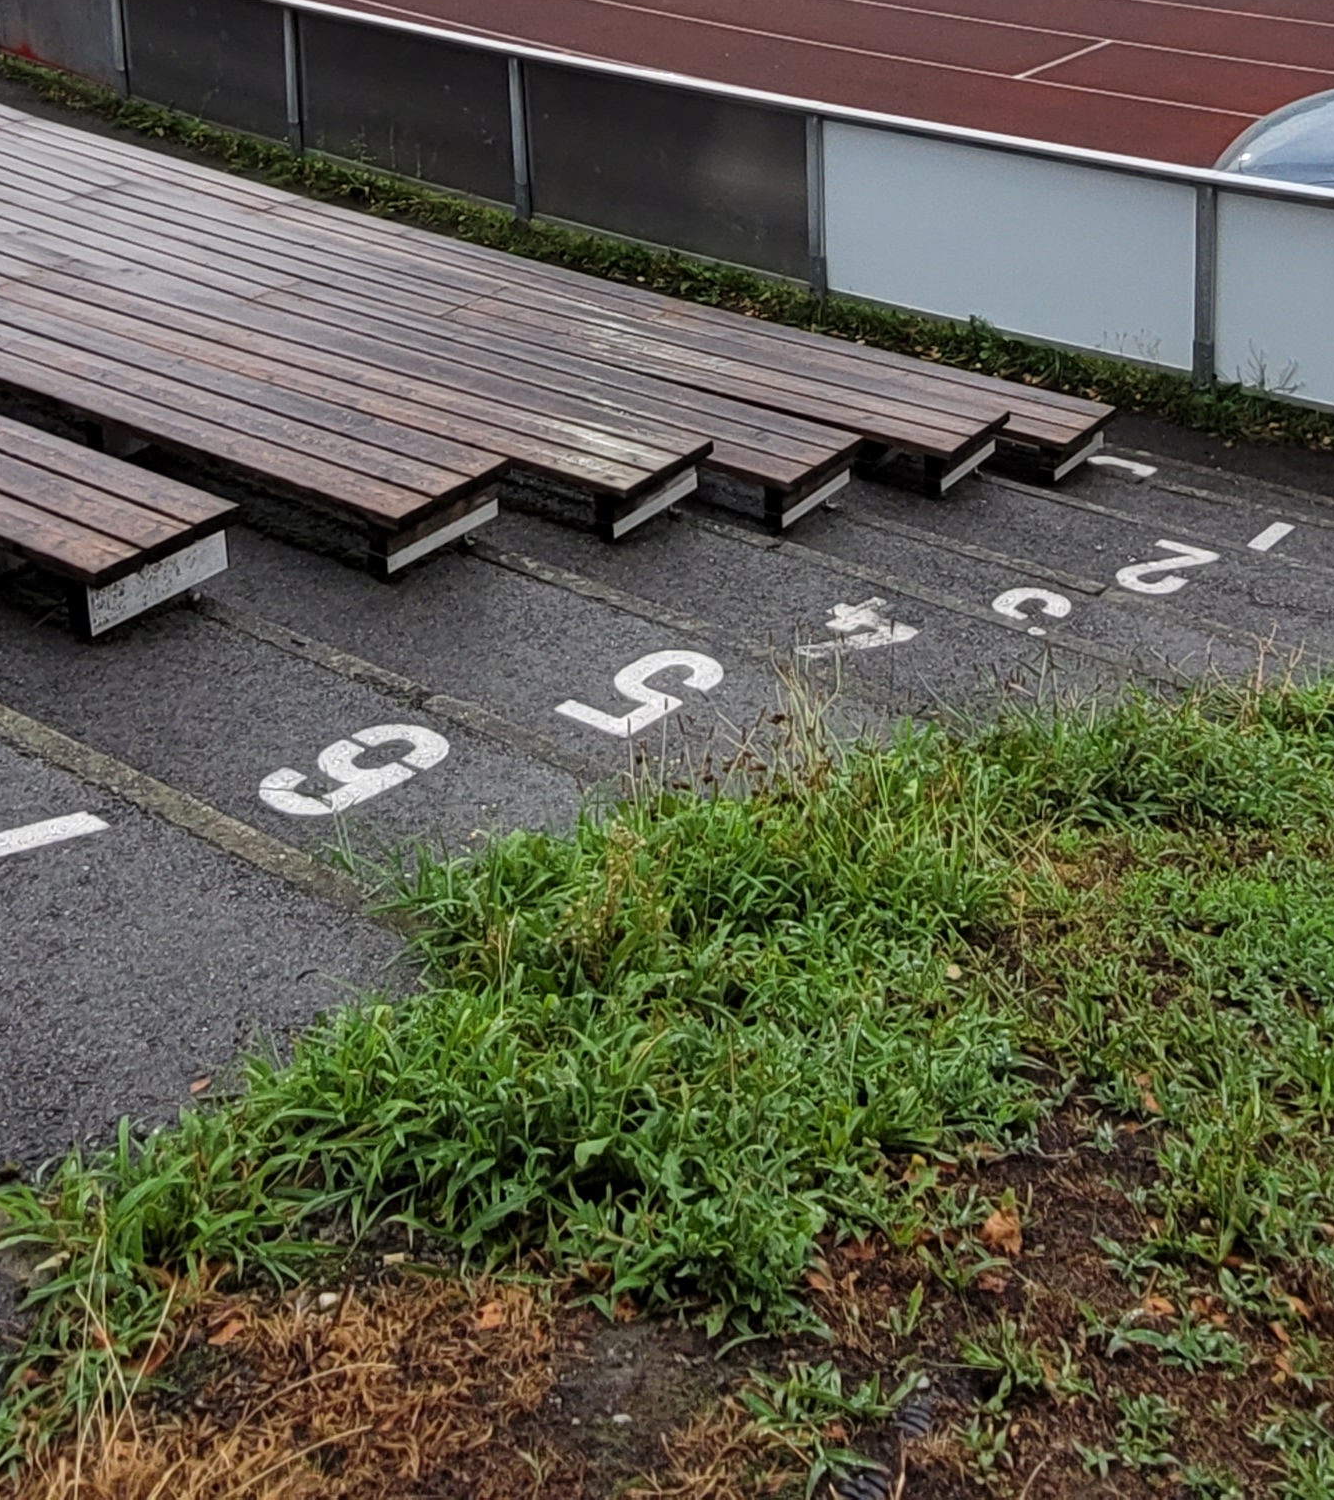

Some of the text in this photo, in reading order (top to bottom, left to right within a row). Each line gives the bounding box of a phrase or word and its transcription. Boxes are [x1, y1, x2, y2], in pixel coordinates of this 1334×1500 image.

[1115, 538, 1220, 594] 2
[554, 649, 724, 738] 5
[259, 723, 450, 815] 6
